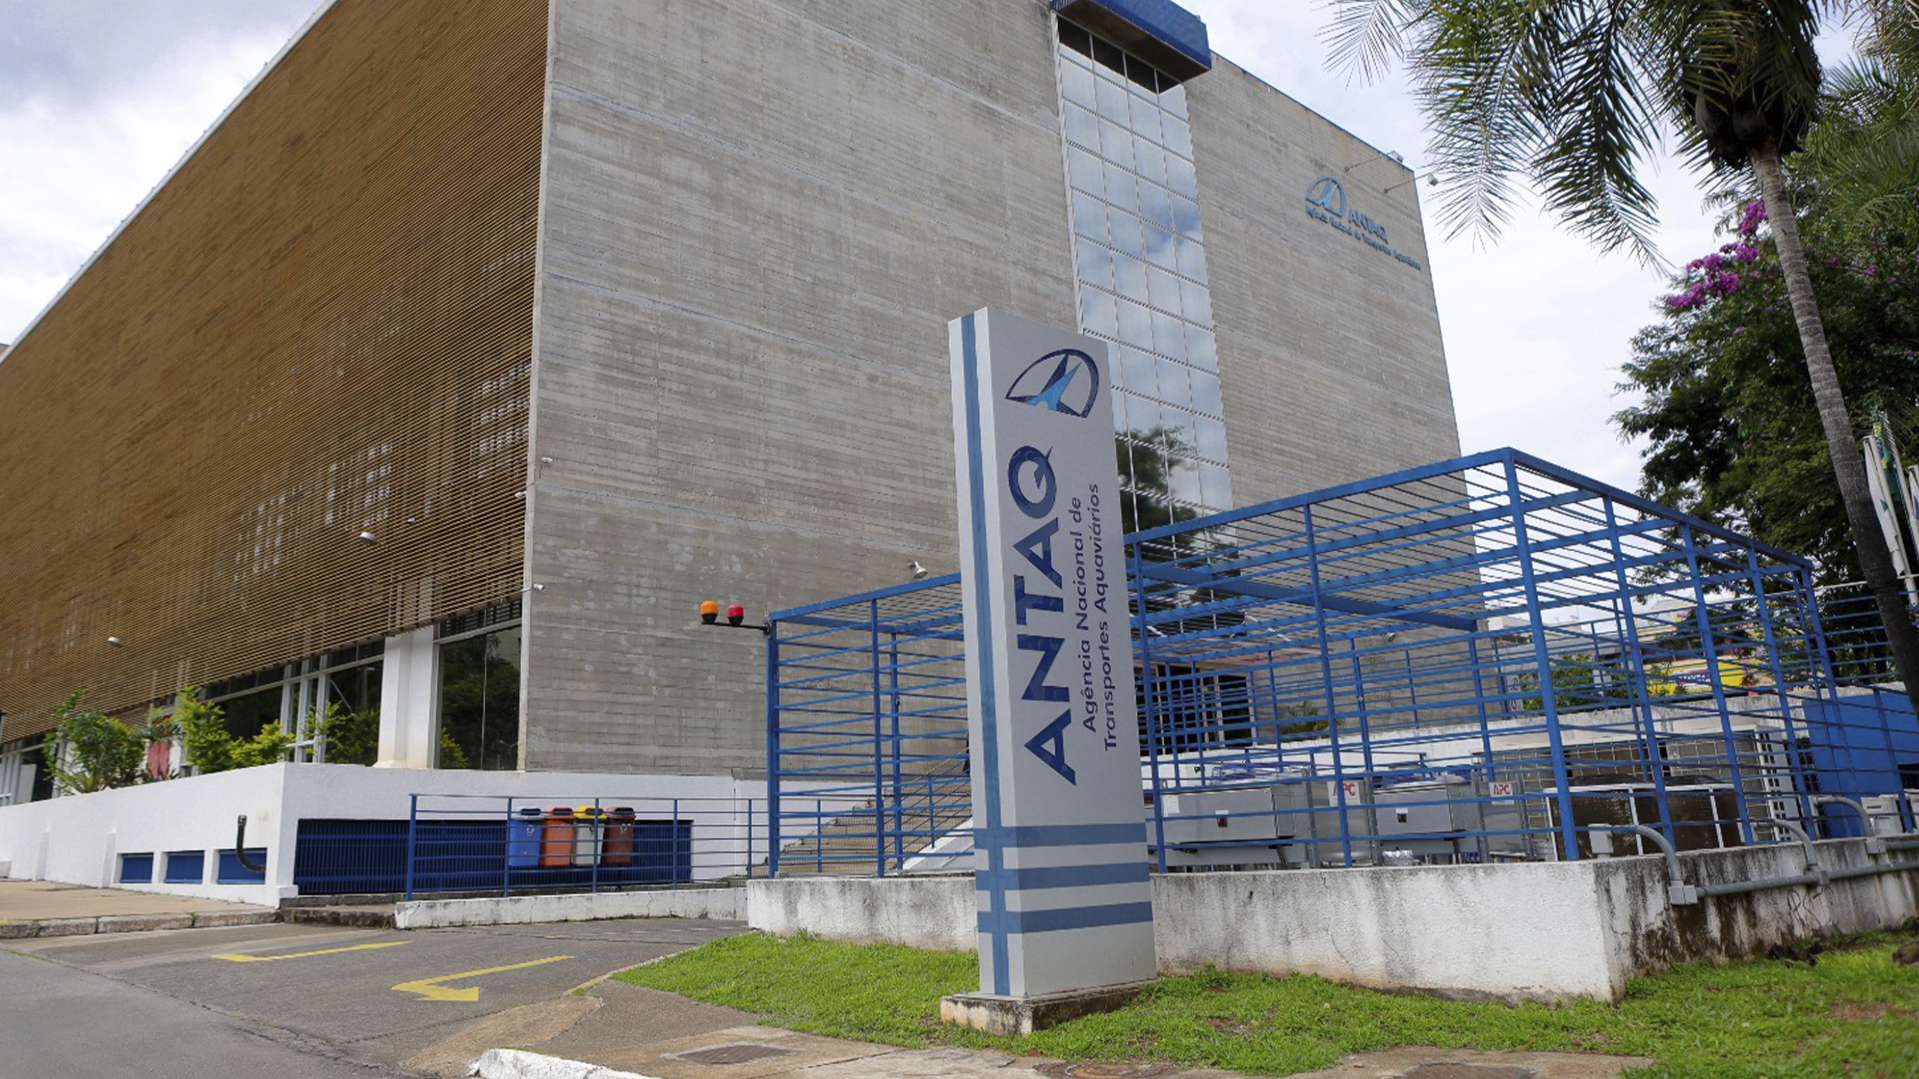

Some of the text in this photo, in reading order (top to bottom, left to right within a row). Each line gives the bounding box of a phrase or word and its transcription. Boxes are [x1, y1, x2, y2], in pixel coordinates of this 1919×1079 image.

[1348, 207, 1389, 245] ANTAQ
[1008, 445, 1077, 787] ANTAQ
[1068, 497, 1099, 733] Agência Nacional de
[1087, 484, 1117, 752] Transportes Aquaviários
